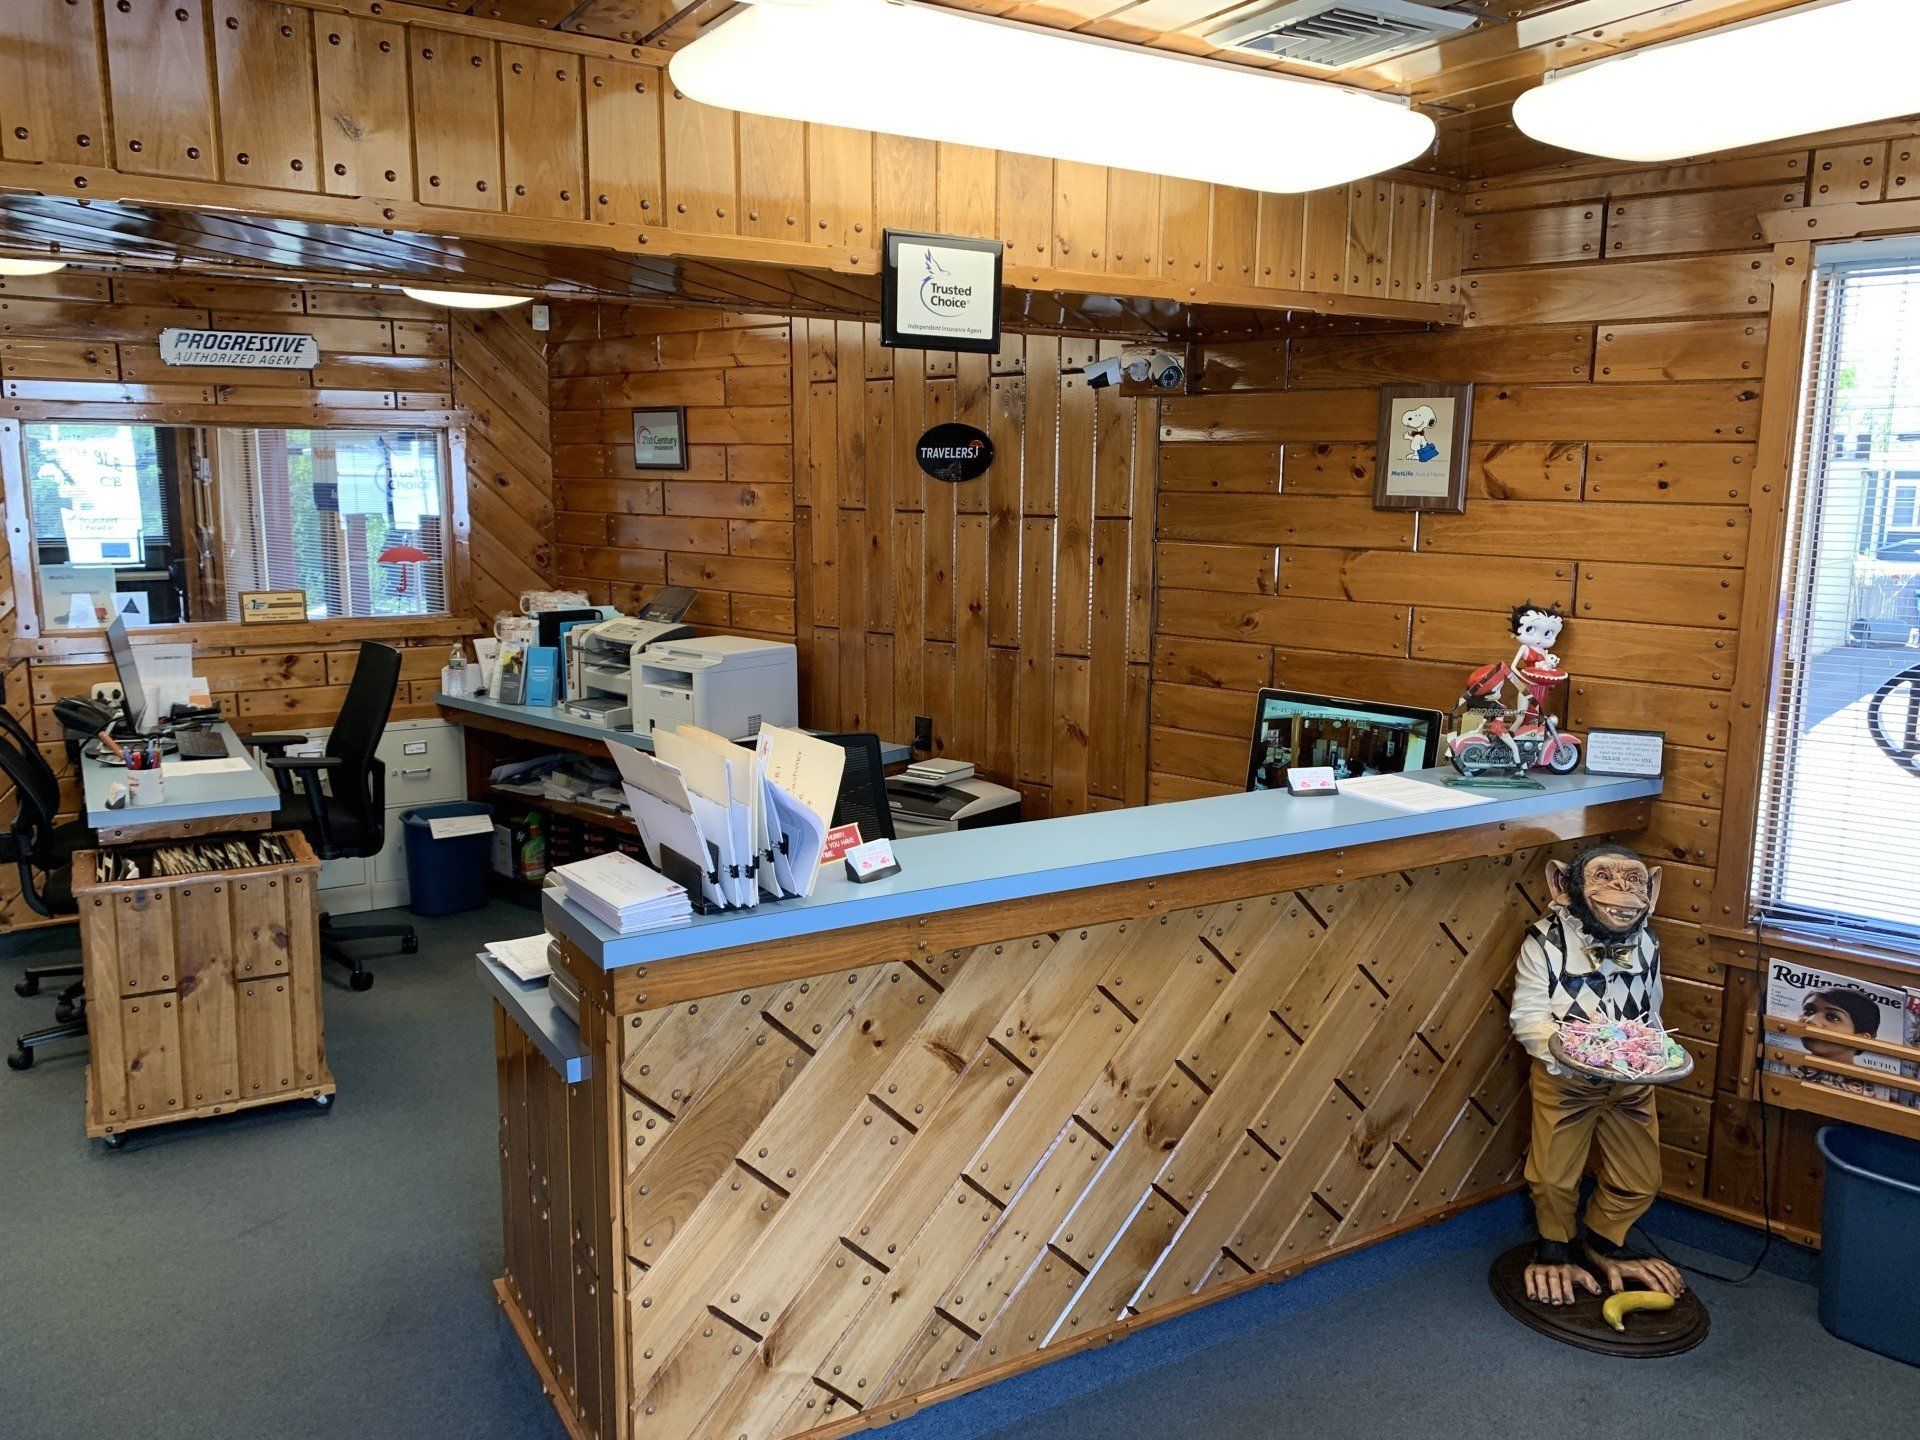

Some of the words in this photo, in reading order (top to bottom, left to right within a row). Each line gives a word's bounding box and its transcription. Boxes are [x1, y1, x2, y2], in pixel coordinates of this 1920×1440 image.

[931, 283, 972, 296] Trusted
[930, 295, 967, 309] Choice
[908, 323, 941, 331] Independent
[967, 327, 982, 335] Agent
[174, 332, 307, 353] PROGRESSIVE
[174, 352, 256, 364] AUTHORIZED
[259, 356, 300, 366] AGENT
[921, 447, 973, 458] TRAVELERS
[829, 841, 841, 849] YOU
[841, 837, 856, 846] HAVE
[1773, 964, 1847, 989] Rollin
